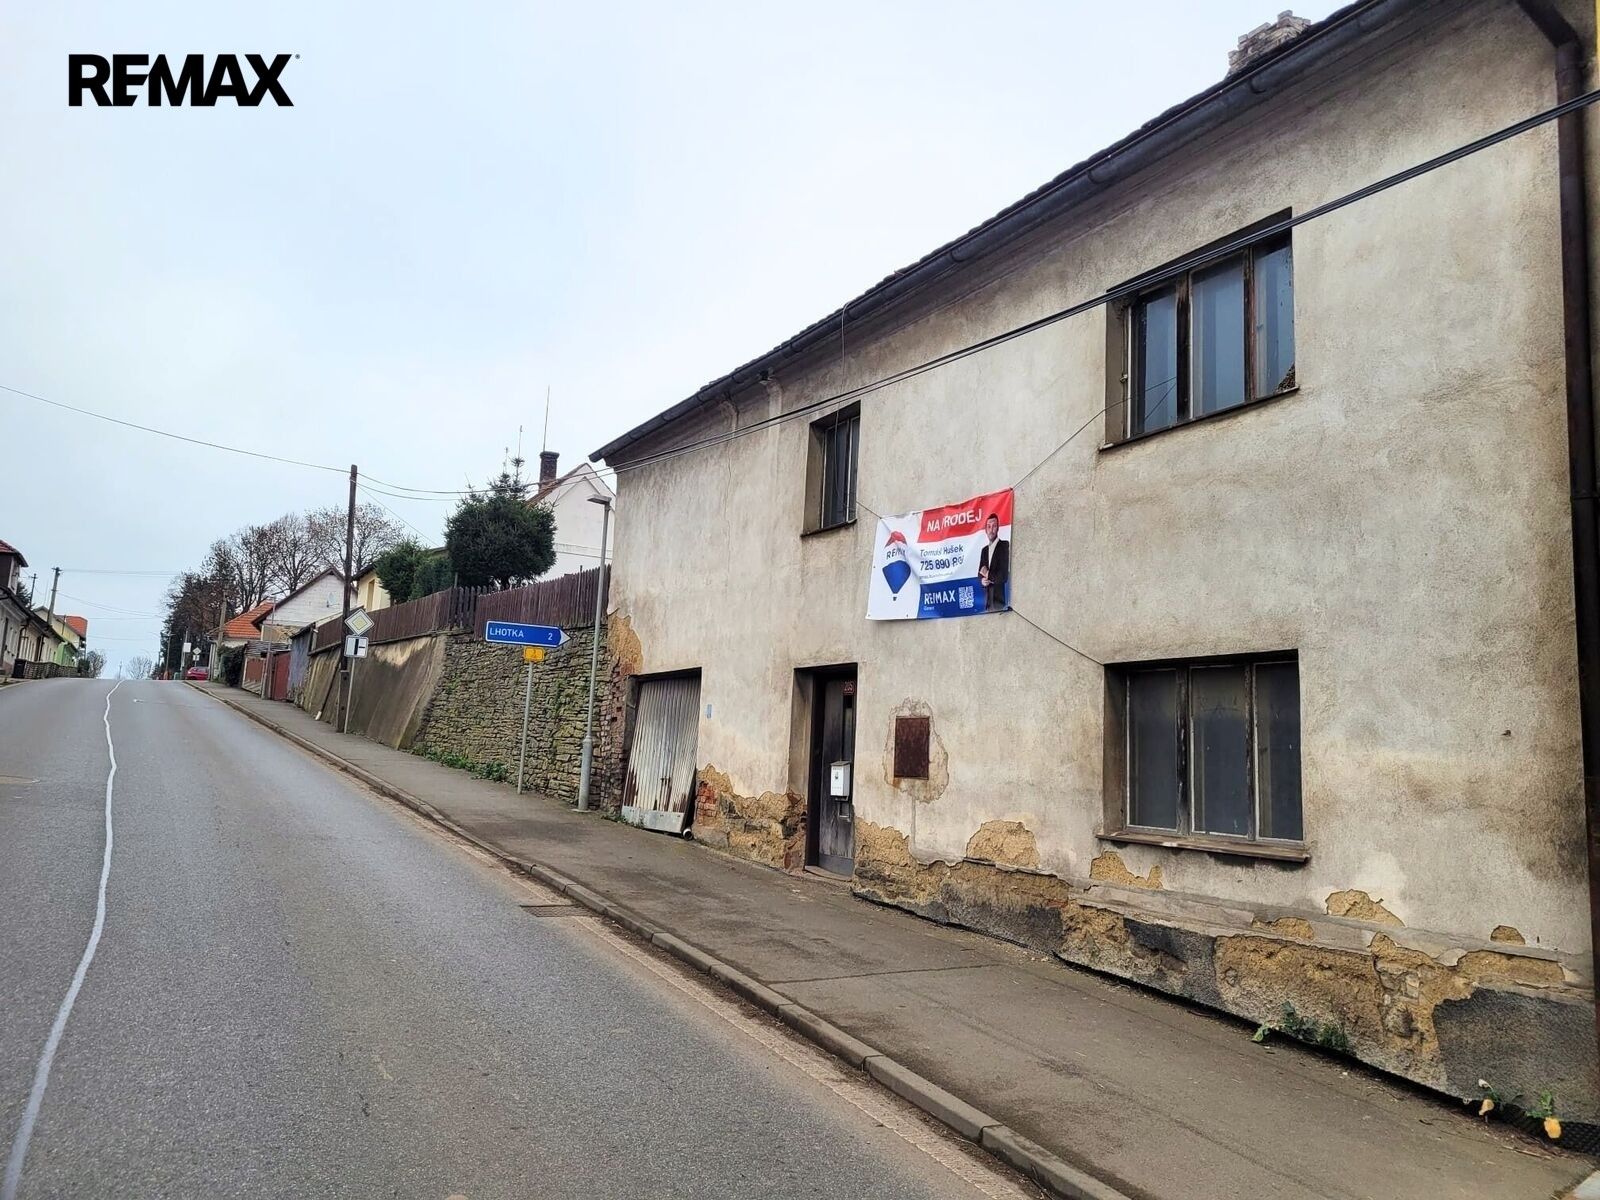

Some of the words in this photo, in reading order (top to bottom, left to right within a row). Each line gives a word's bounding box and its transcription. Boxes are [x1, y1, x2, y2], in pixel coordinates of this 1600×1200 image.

[927, 519, 940, 532] NA
[920, 560, 934, 571] 725
[935, 558, 951, 569] 890
[489, 627, 524, 638] LHOTKA
[547, 632, 553, 641] 2
